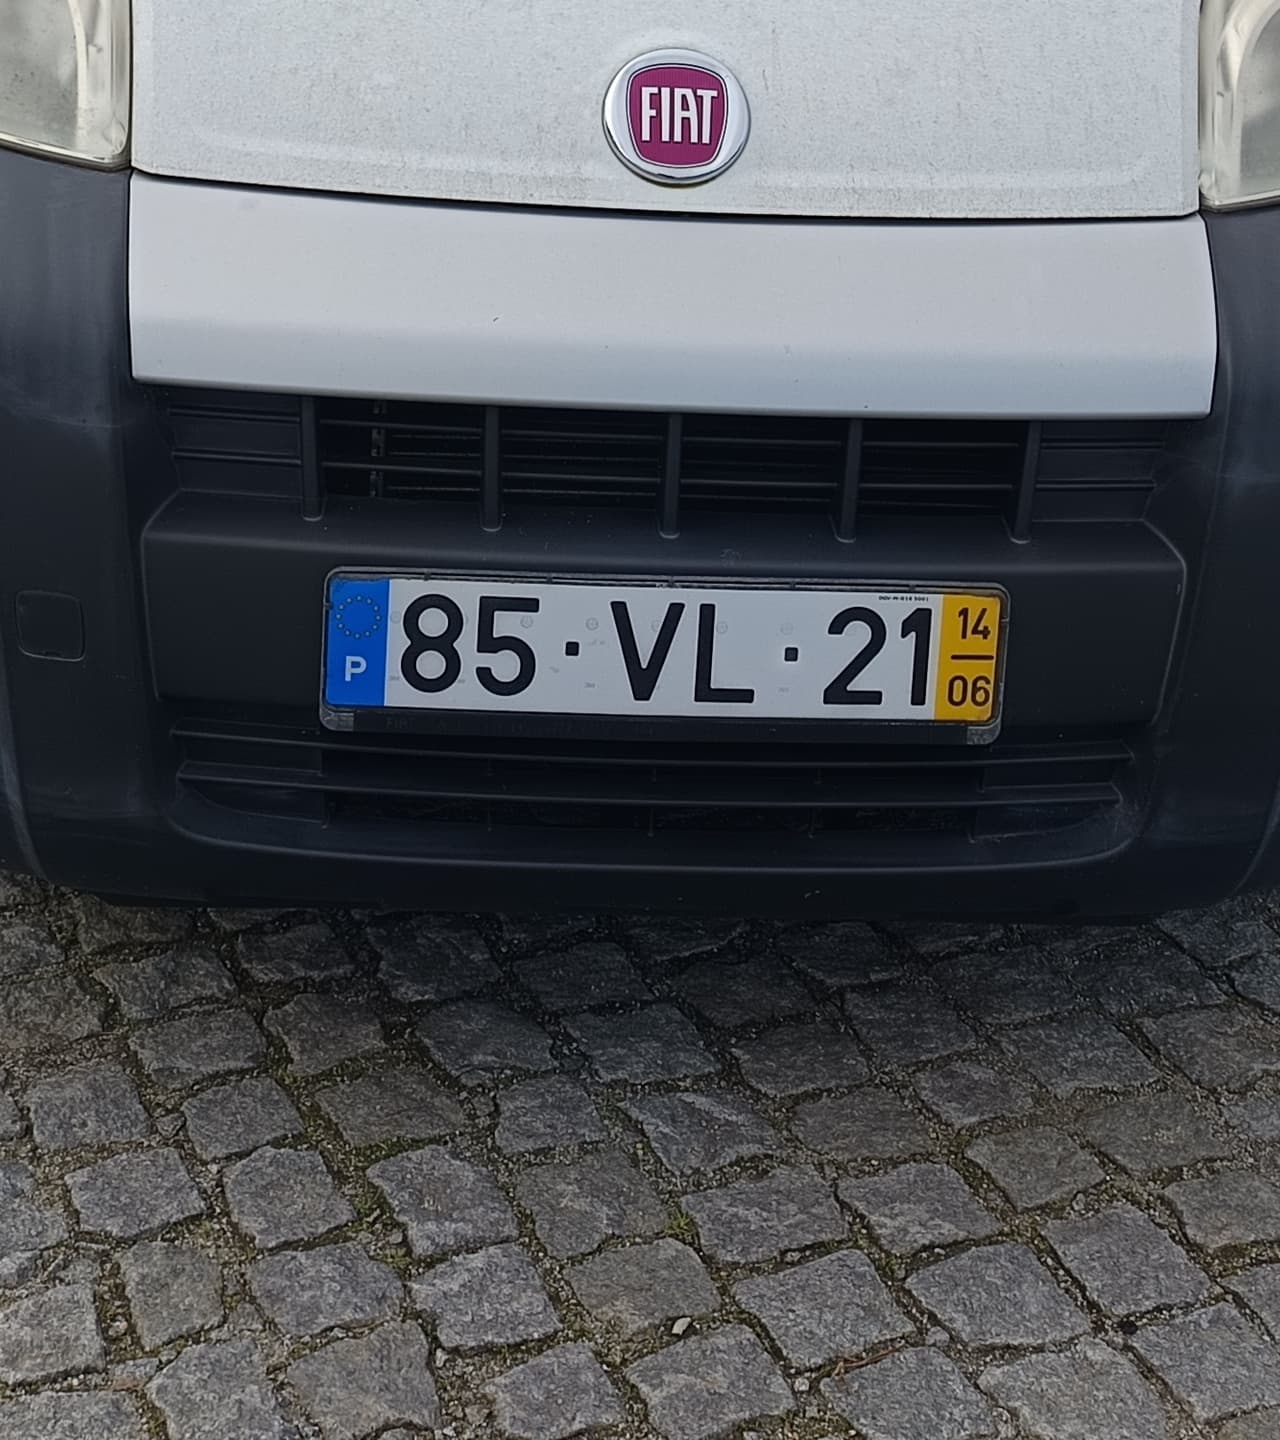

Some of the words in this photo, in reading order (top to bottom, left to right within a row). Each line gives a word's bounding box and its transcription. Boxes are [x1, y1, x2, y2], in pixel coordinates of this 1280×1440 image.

[641, 86, 718, 144] FIAT
[958, 607, 991, 640] 14
[344, 656, 367, 682] P
[947, 674, 991, 707] 06
